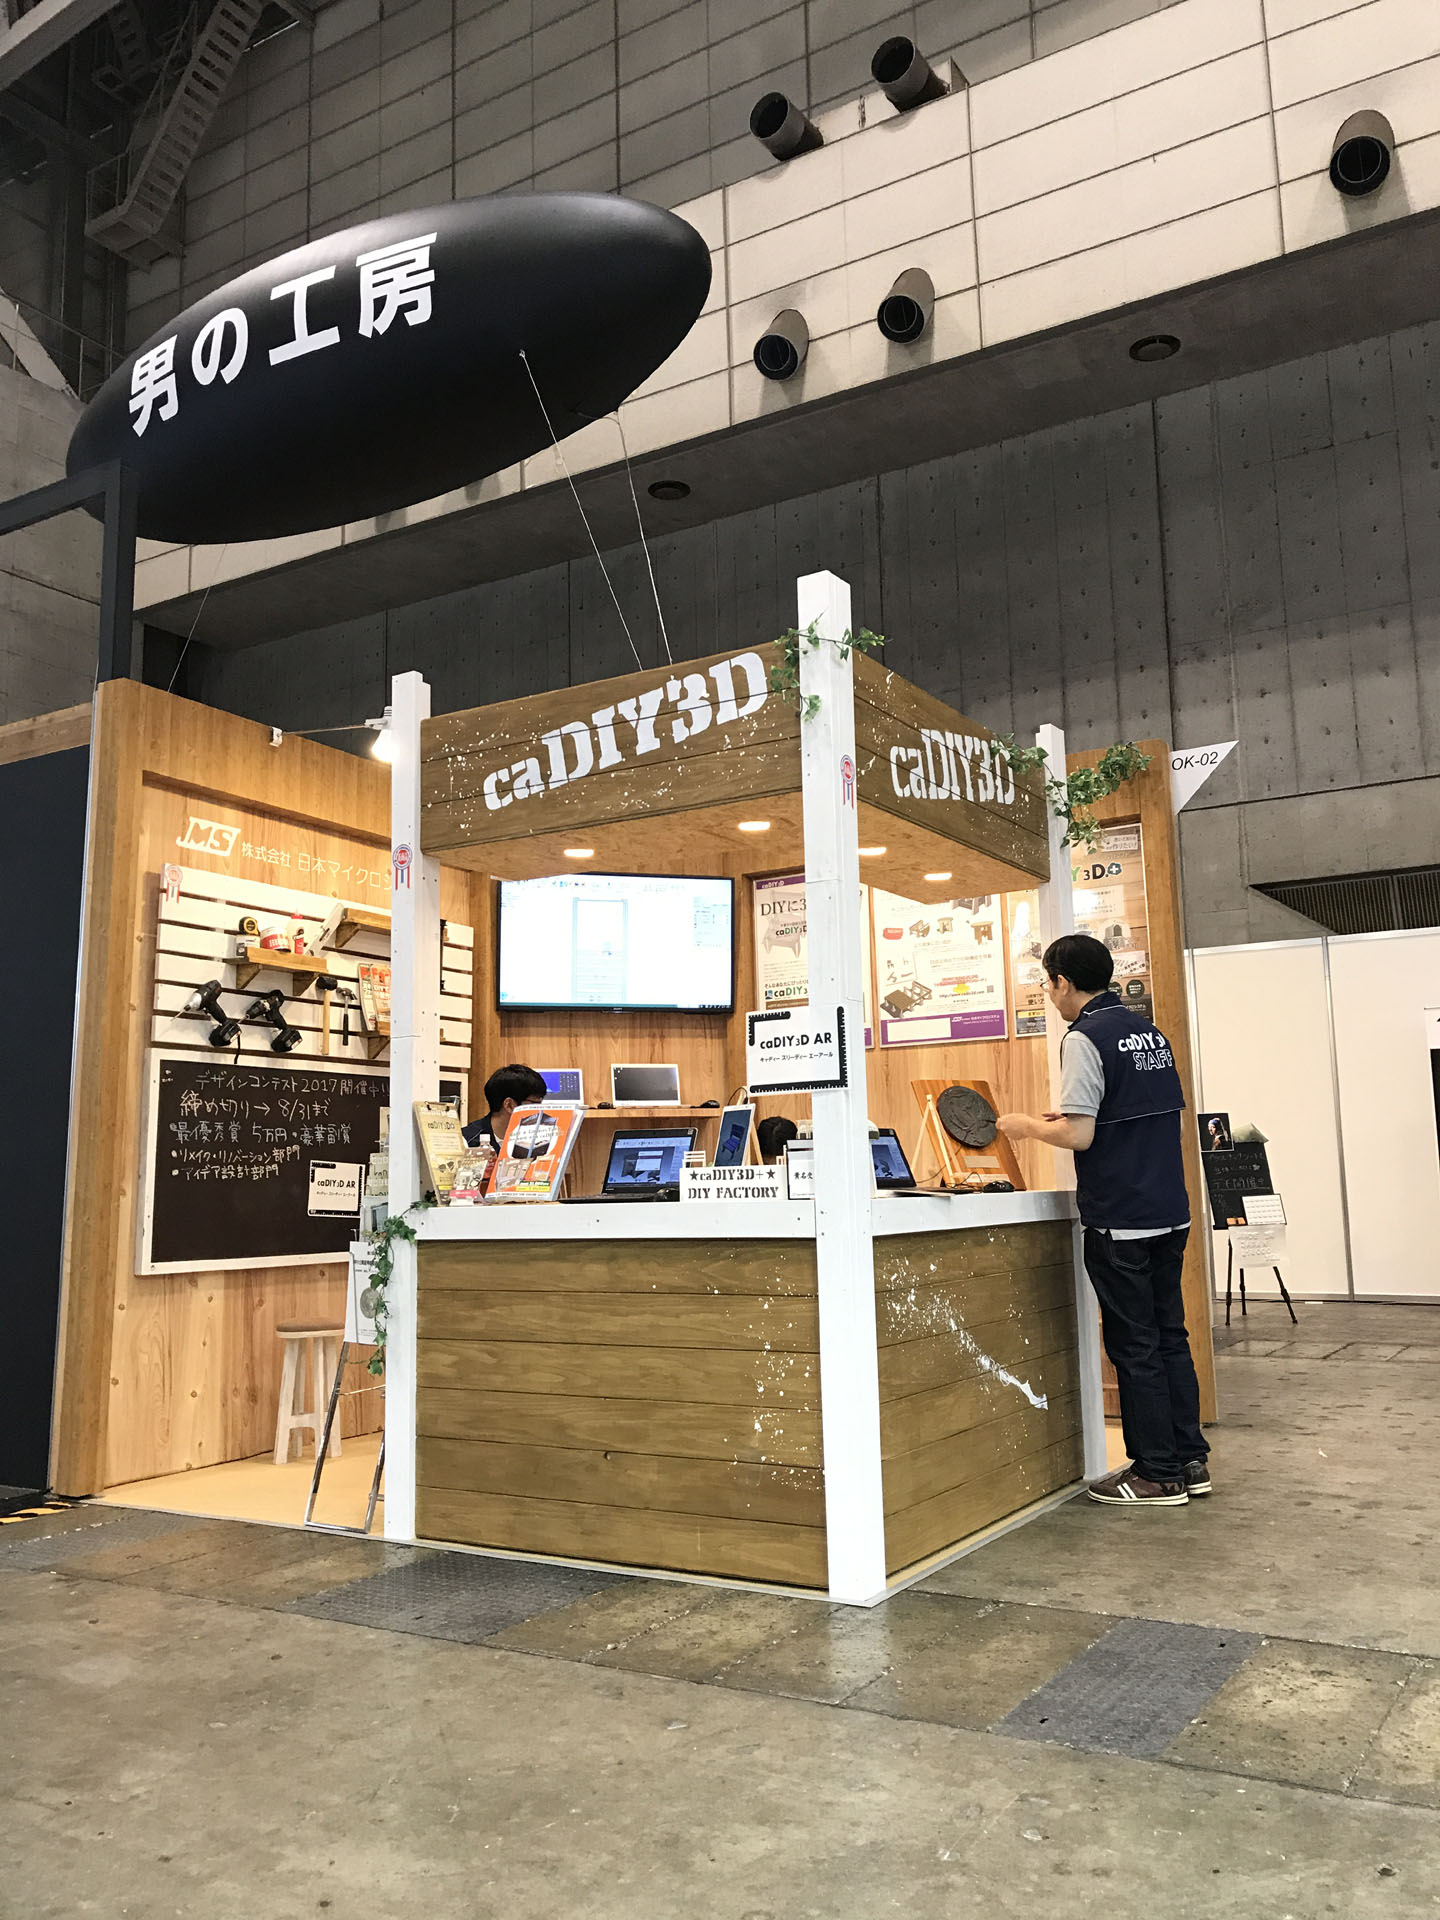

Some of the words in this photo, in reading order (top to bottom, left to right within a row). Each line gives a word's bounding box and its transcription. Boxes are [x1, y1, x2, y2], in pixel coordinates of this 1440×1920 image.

[128, 232, 438, 437] 男の工房
[483, 651, 769, 811] caDIY3D
[889, 727, 1016, 805] caDIY3D
[1171, 751, 1219, 771] OK-02
[241, 840, 291, 868] 株式会社
[760, 1034, 810, 1050] caDIY3D
[813, 1032, 833, 1045] AR
[1133, 1048, 1173, 1071] STAFF
[346, 1180, 356, 1189] AR
[687, 1187, 711, 1200] DIY
[716, 1186, 779, 1199] FACTORY
